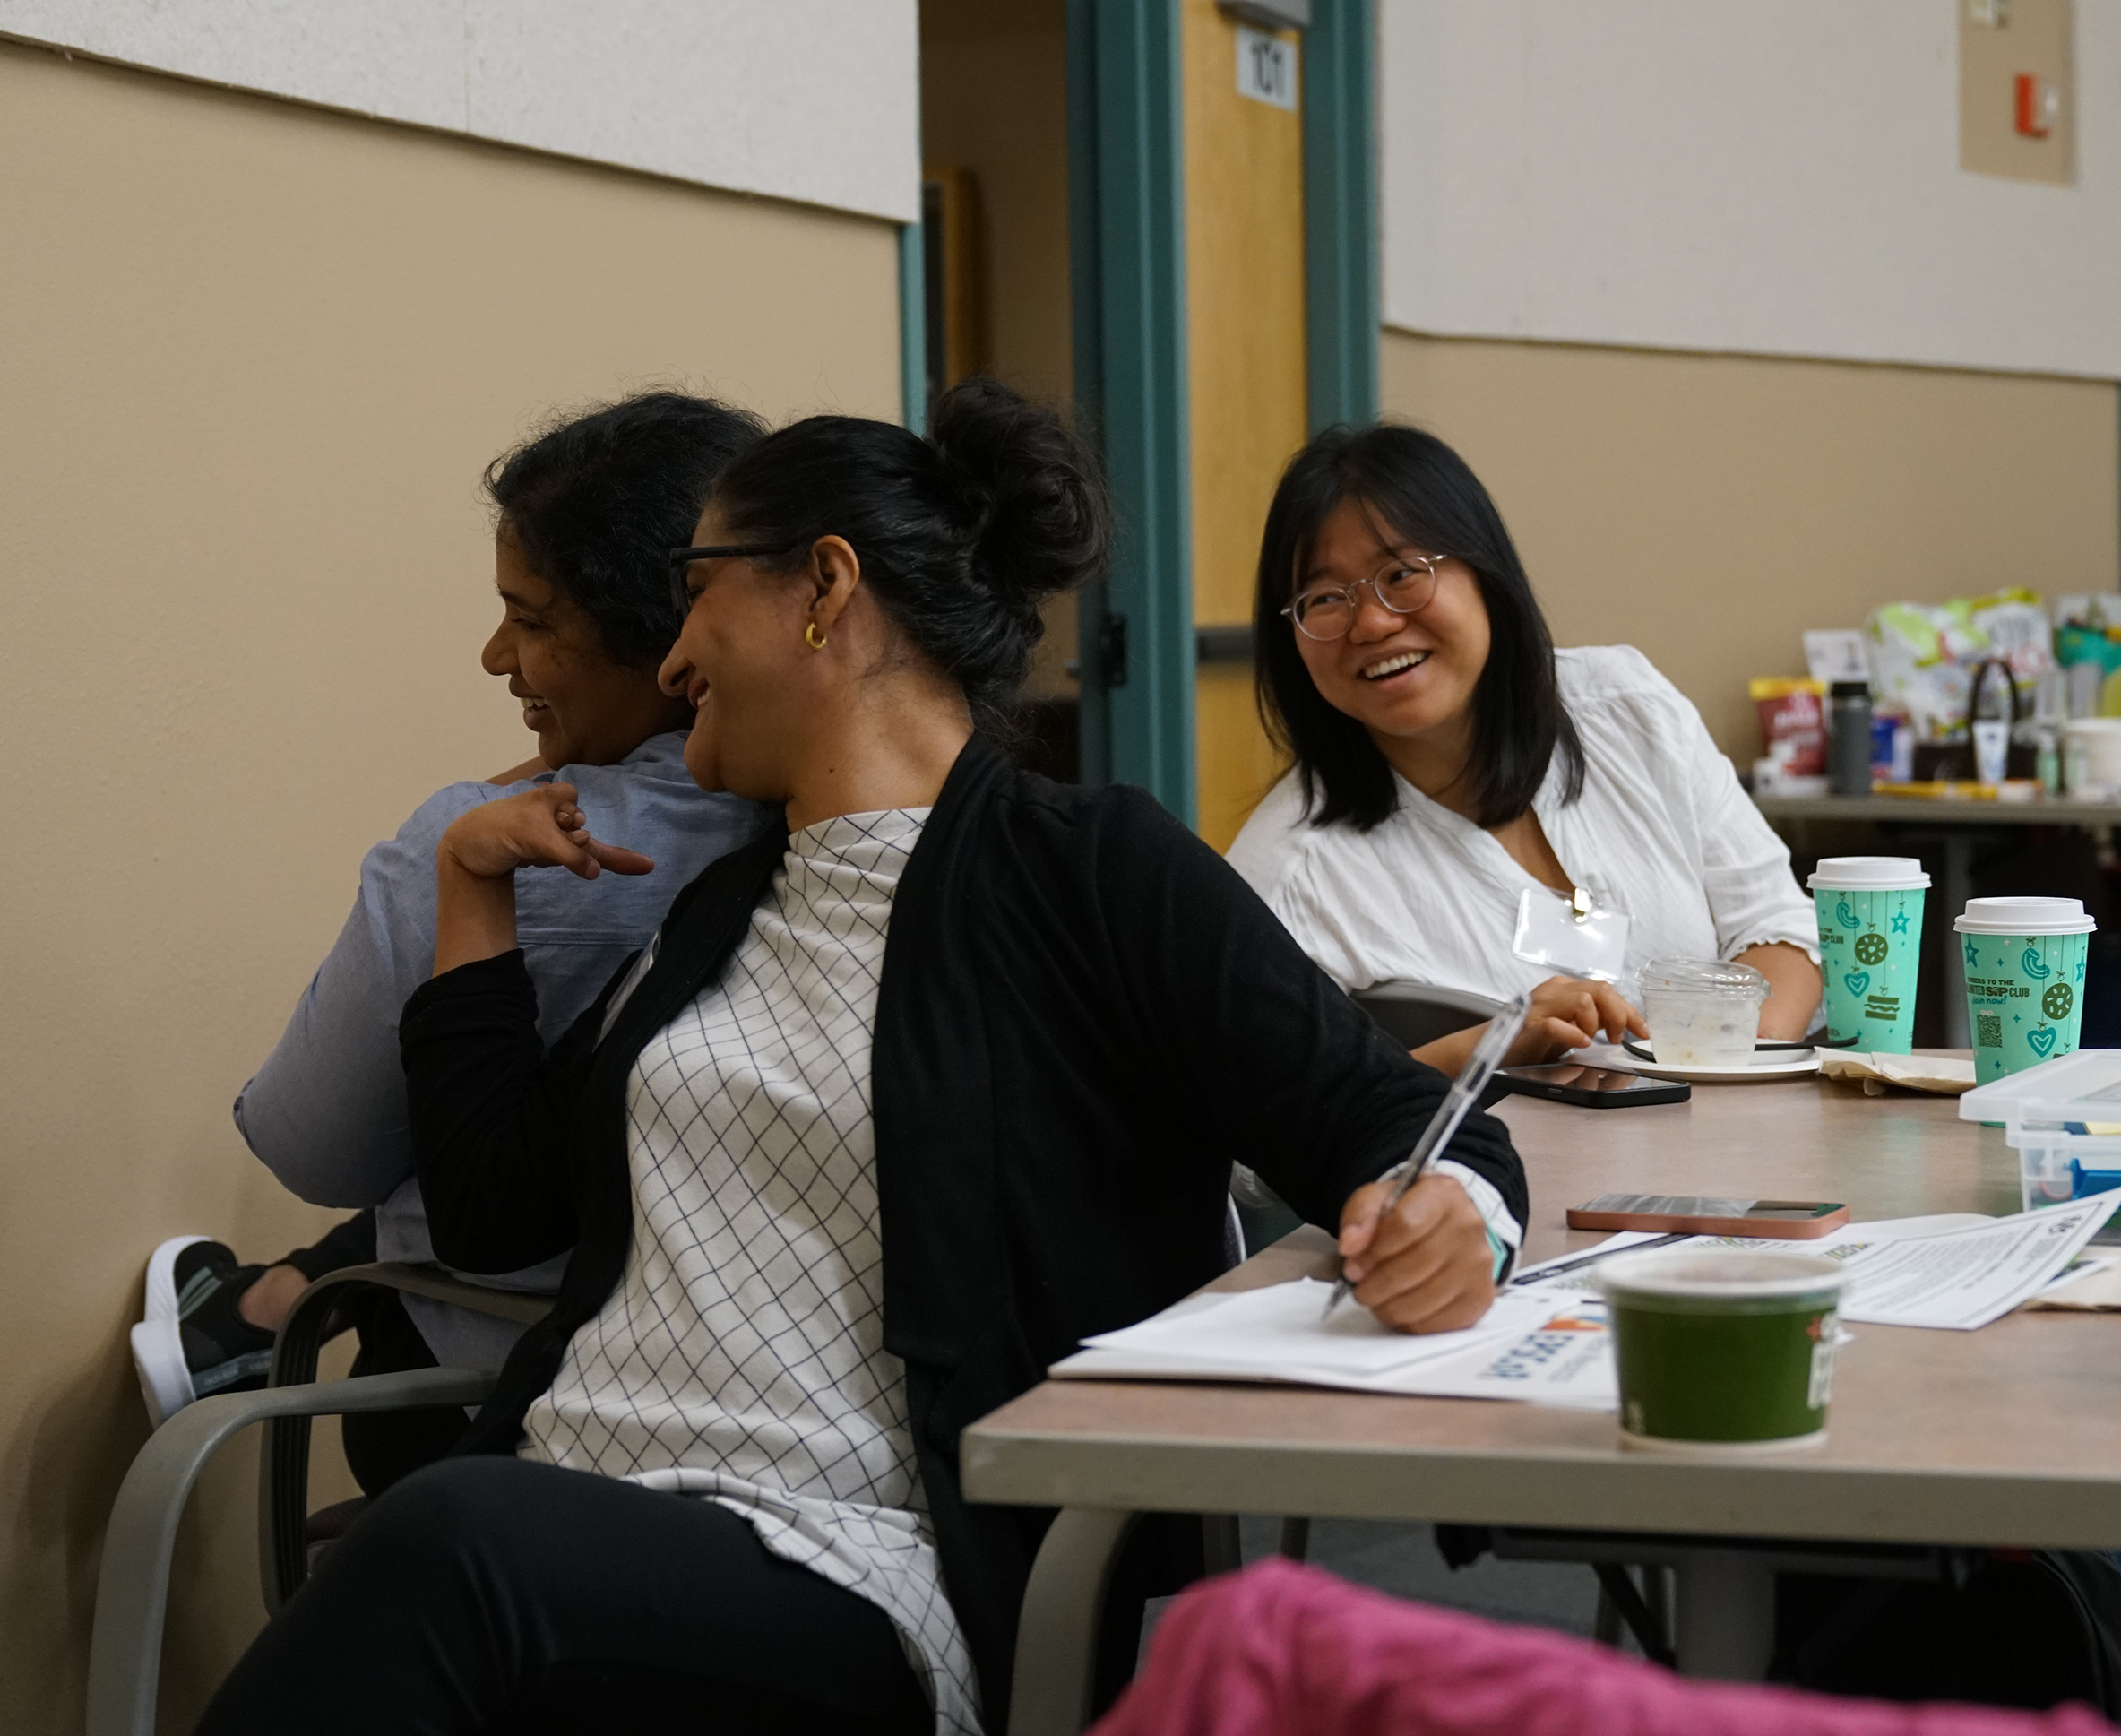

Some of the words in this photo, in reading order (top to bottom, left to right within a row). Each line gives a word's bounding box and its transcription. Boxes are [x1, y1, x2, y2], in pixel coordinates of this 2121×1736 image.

[1250, 41, 1285, 98] 101
[2009, 987, 2030, 998] CLUB
[1987, 995, 2007, 1005] now!
